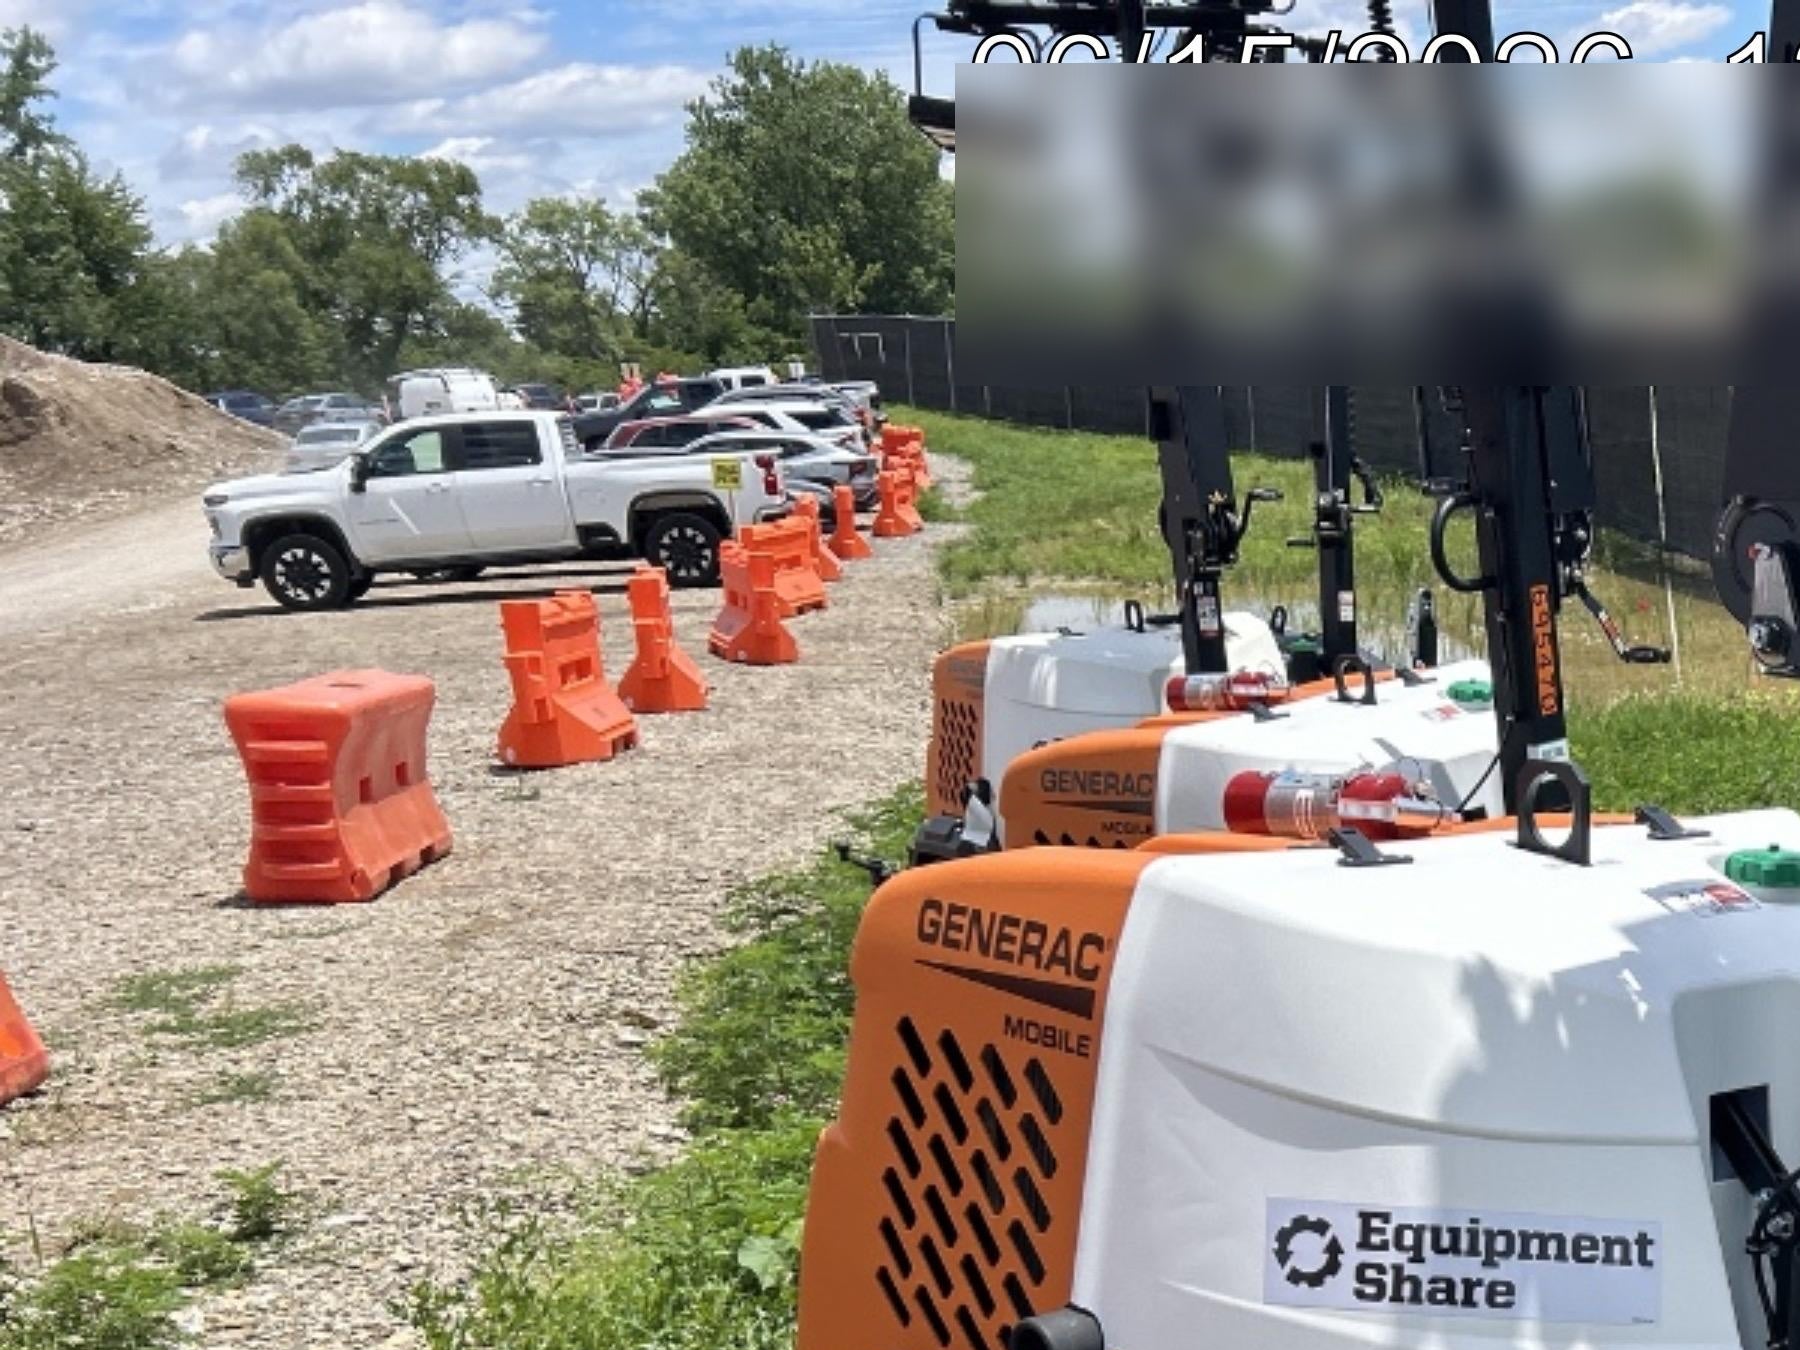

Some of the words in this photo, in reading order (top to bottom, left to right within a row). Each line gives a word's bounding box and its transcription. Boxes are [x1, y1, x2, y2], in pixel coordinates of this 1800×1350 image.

[1040, 769, 1154, 798] GENERAC
[917, 899, 1105, 982] GENERAC
[1003, 1013, 1091, 1058] MOBILE
[1355, 1210, 1655, 1268] Equipment
[1352, 1262, 1516, 1309] Share
